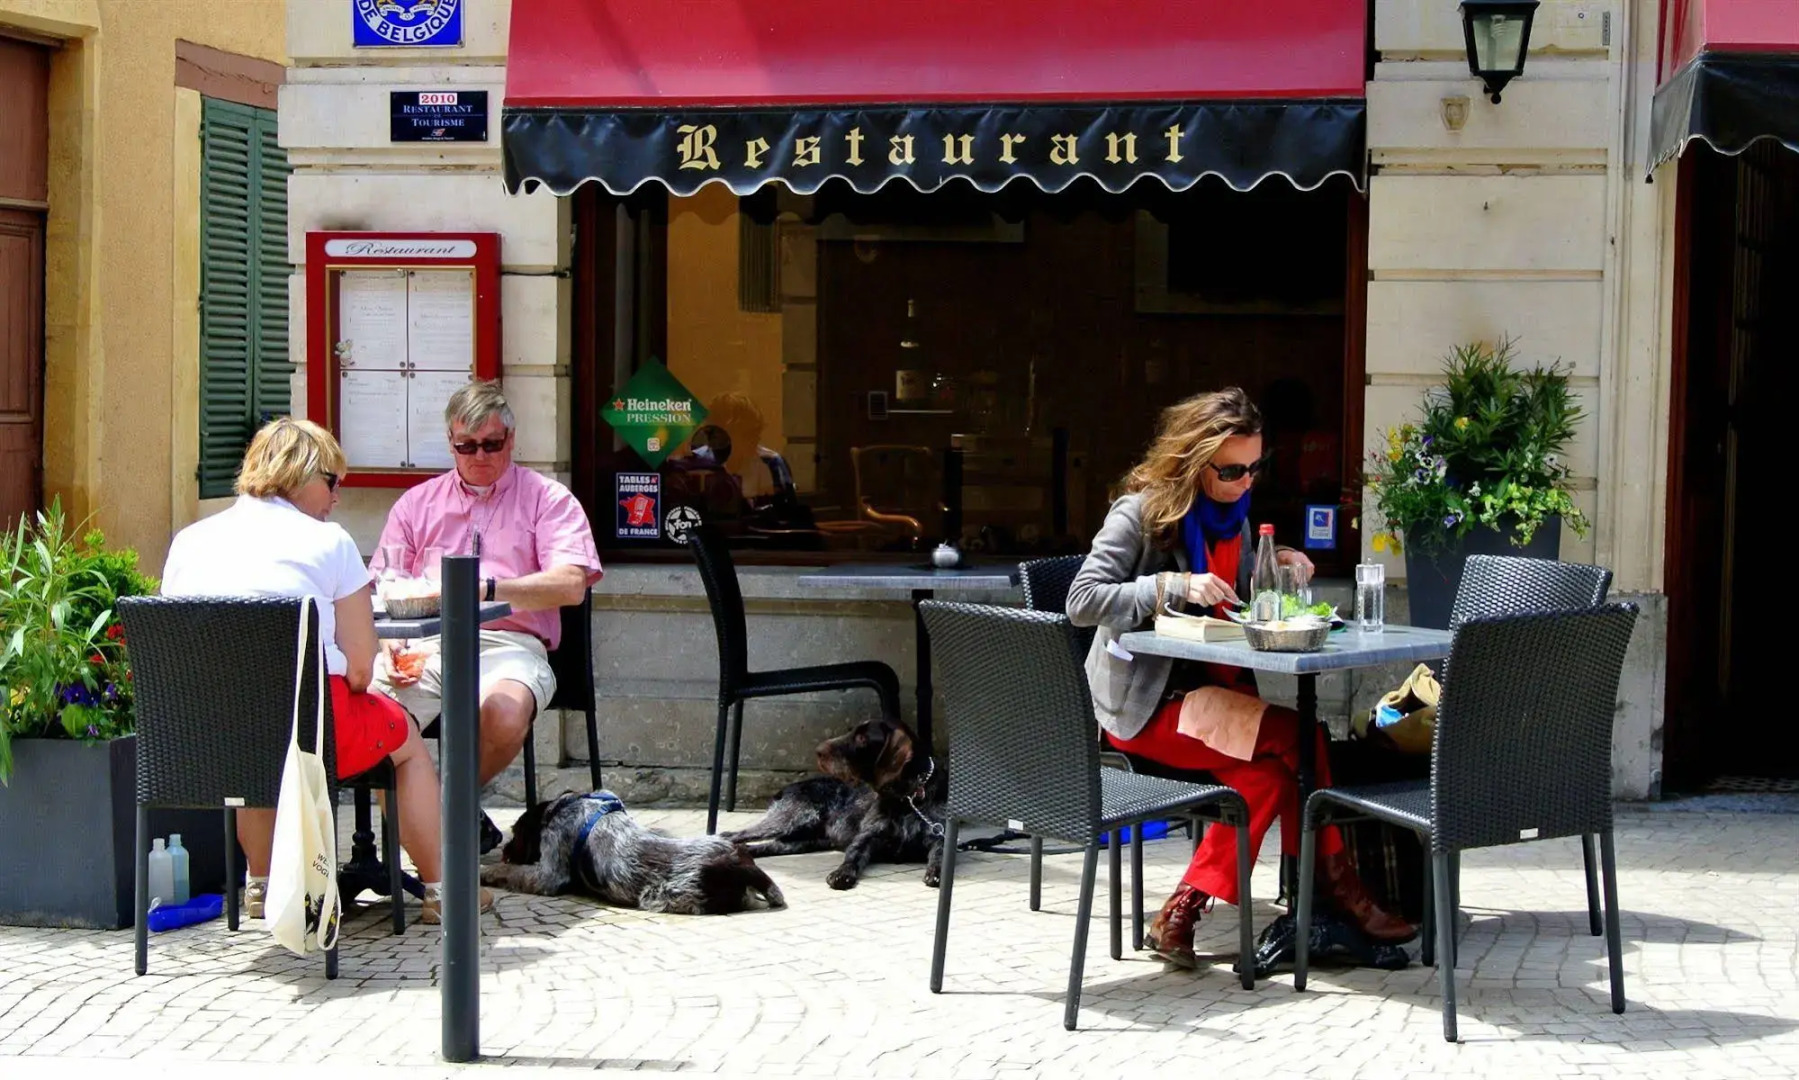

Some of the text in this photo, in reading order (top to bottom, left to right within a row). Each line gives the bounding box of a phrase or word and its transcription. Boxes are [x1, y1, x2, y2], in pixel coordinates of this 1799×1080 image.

[359, 0, 456, 42] DE BELGIQUE
[421, 95, 455, 103] 2010
[677, 123, 1185, 170] Restaurant
[345, 241, 455, 255] Restaurant
[627, 399, 692, 411] Heineken
[627, 413, 691, 422] PRESSION
